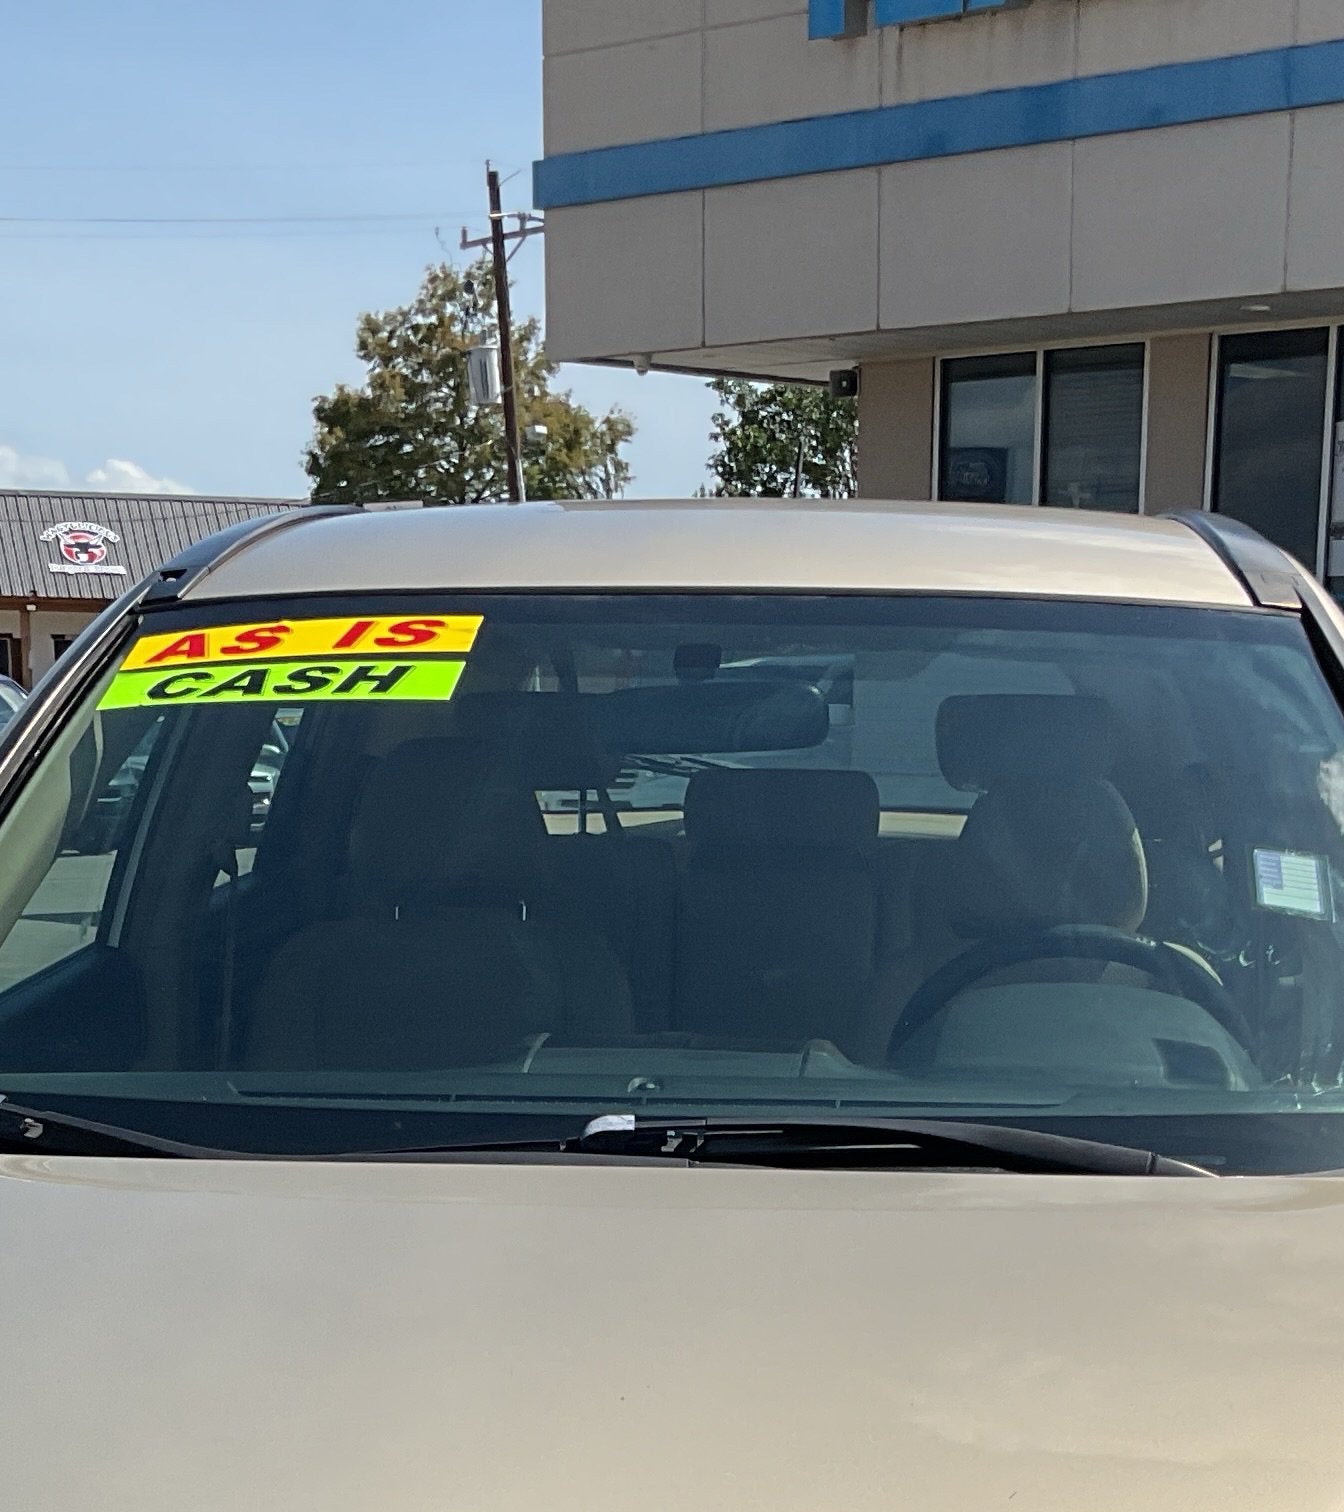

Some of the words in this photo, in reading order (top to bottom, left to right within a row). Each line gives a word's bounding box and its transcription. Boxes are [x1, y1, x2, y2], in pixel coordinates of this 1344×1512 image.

[145, 625, 292, 664] AS
[332, 620, 449, 650] IS
[147, 665, 417, 699] CASH
